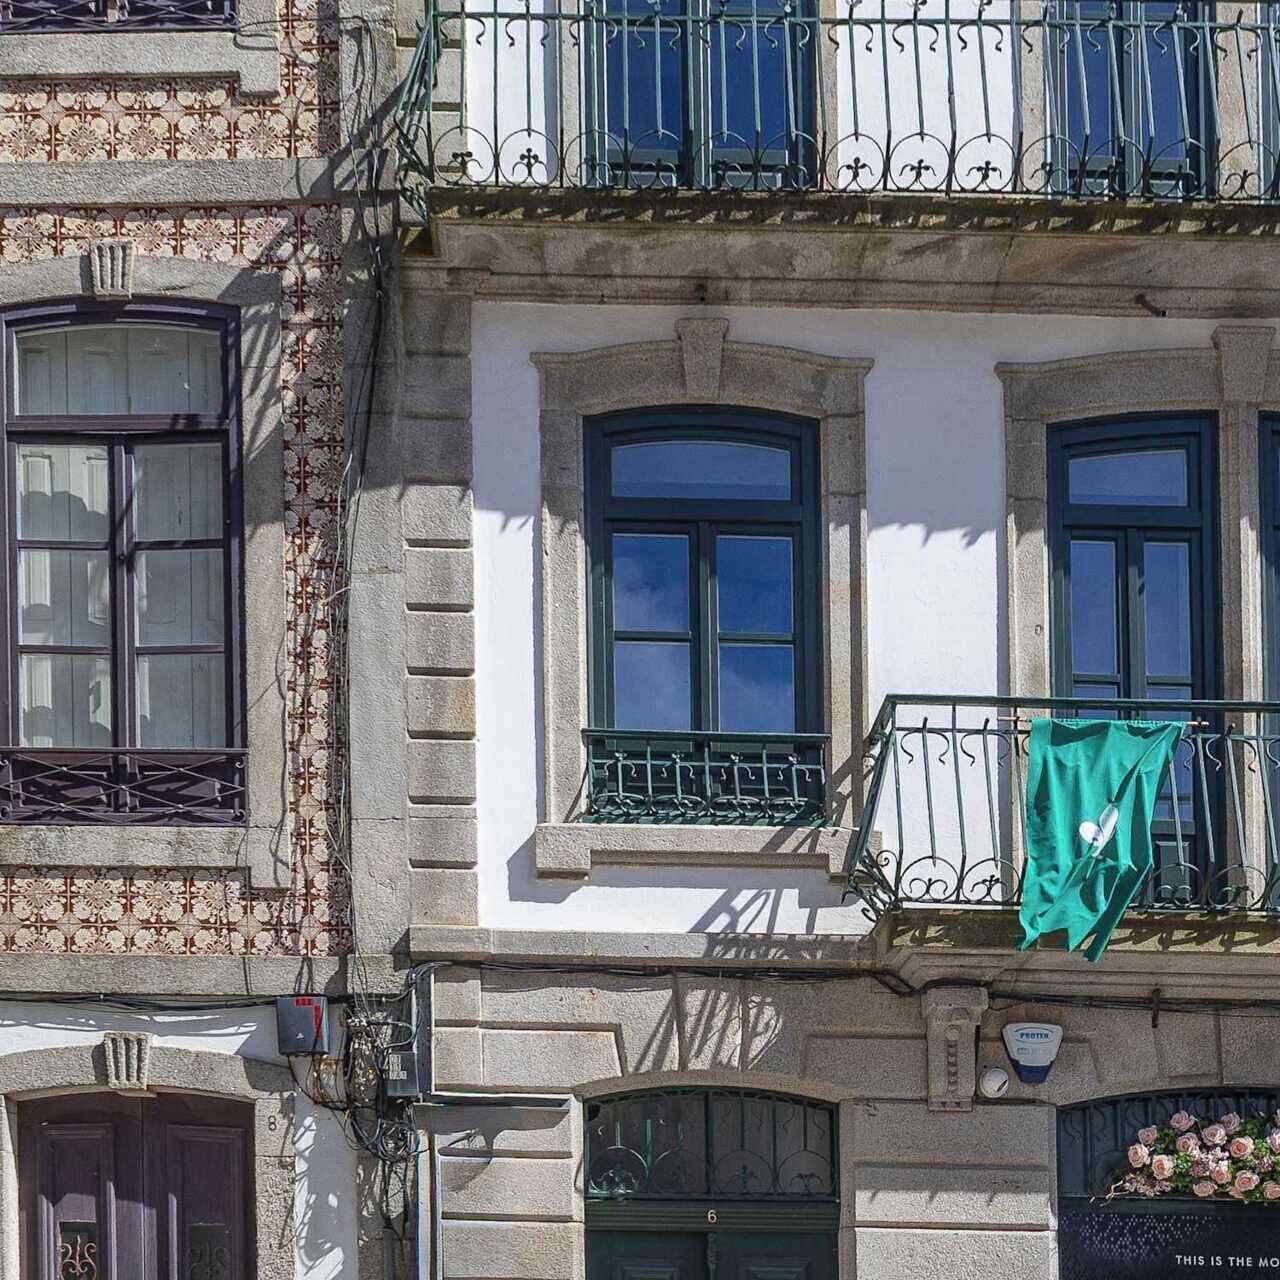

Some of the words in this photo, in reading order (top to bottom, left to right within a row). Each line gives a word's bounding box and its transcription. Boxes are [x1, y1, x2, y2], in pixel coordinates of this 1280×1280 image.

[267, 1115, 277, 1131] 8
[707, 1209, 718, 1223] 6
[1175, 1254, 1205, 1266] THIS
[1210, 1256, 1222, 1266] IS
[1228, 1256, 1253, 1267] THE
